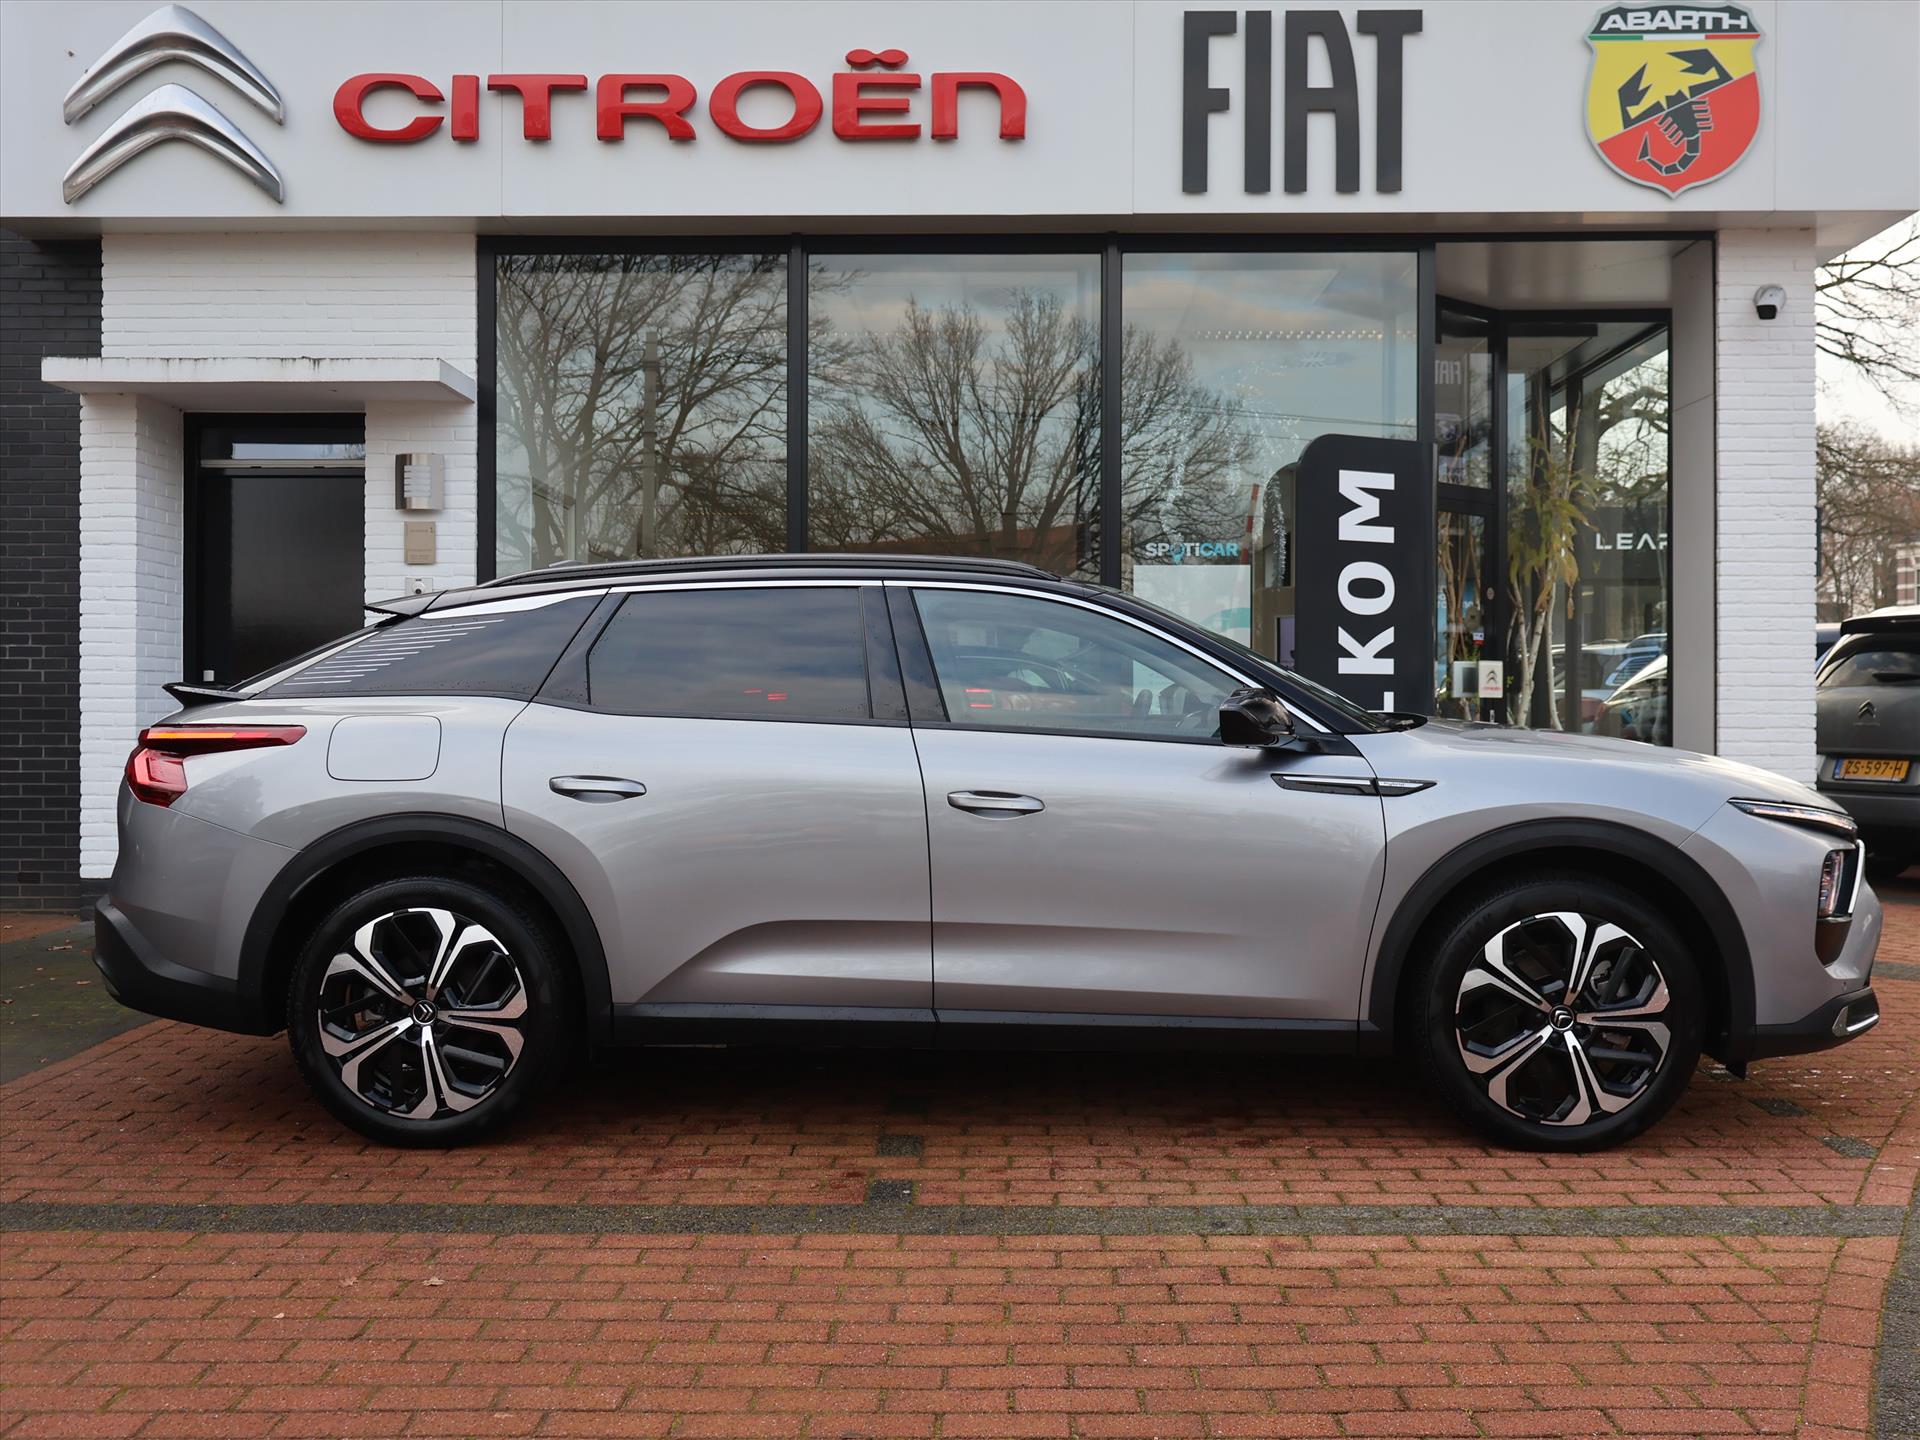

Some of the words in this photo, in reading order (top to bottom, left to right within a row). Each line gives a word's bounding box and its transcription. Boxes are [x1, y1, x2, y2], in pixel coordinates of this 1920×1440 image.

[1600, 9, 1748, 31] ABARTH
[1182, 9, 1423, 194] FIAT
[1845, 759, 1903, 776] ZS-597-H
